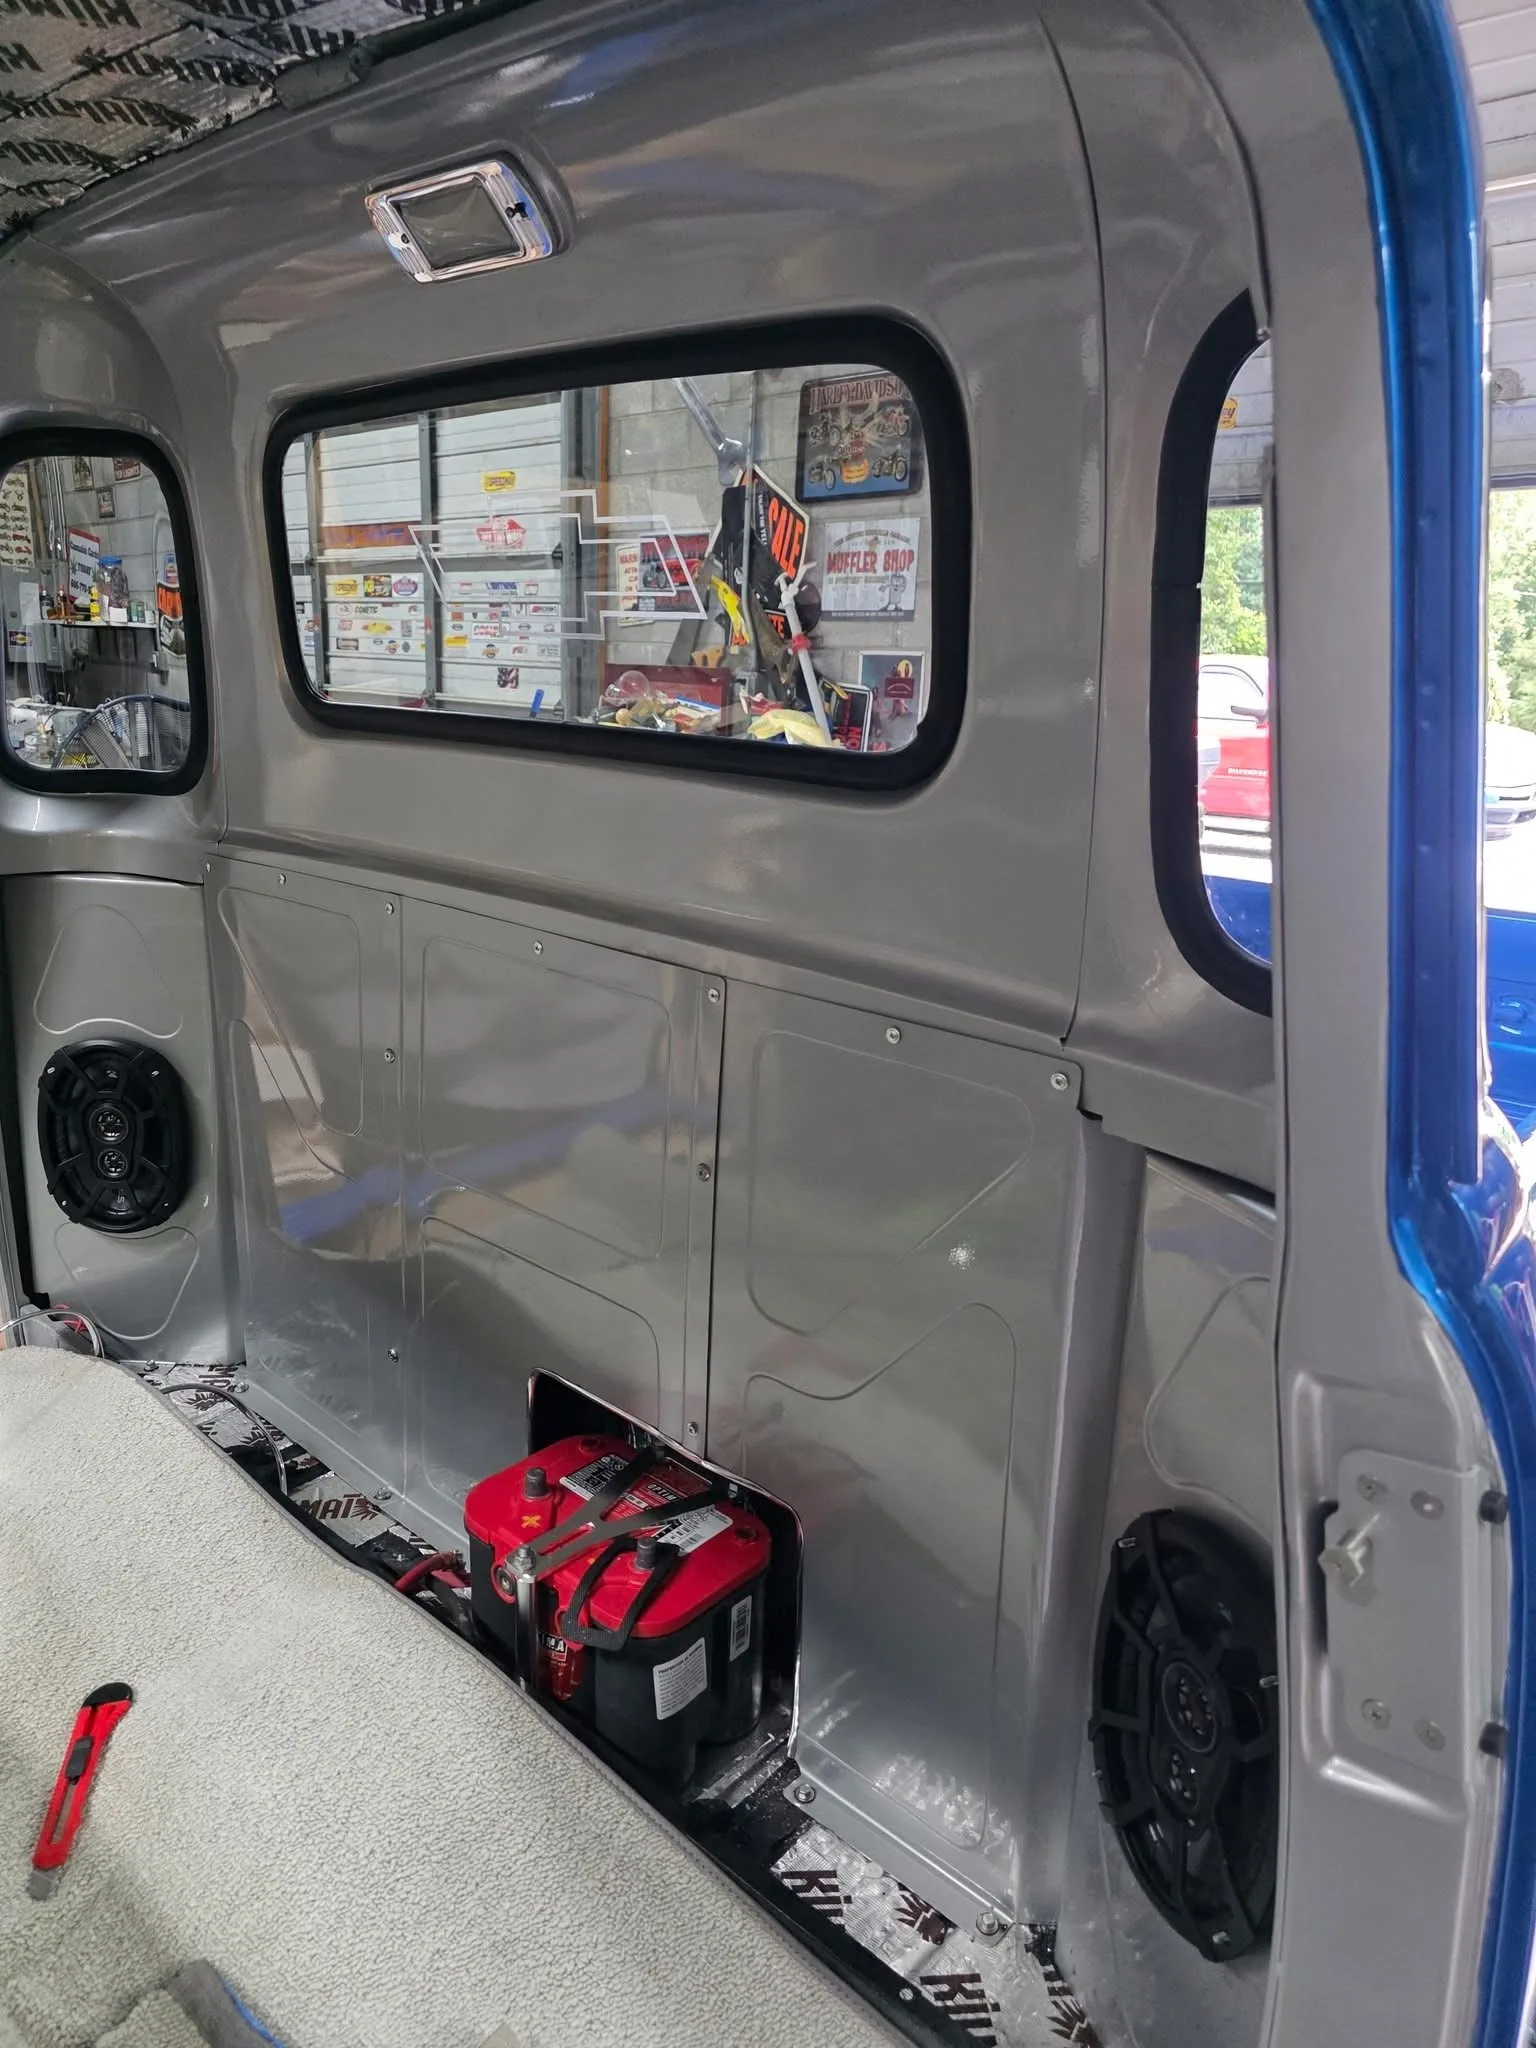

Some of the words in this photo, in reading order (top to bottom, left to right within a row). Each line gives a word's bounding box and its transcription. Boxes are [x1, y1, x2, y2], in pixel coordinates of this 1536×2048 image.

[808, 375, 911, 414] HARLEY-DAVIDSO
[768, 497, 805, 581] SALE
[826, 550, 878, 575] MUFFLER
[882, 548, 915, 573] SHOP
[647, 1483, 680, 1501] OPTIM
